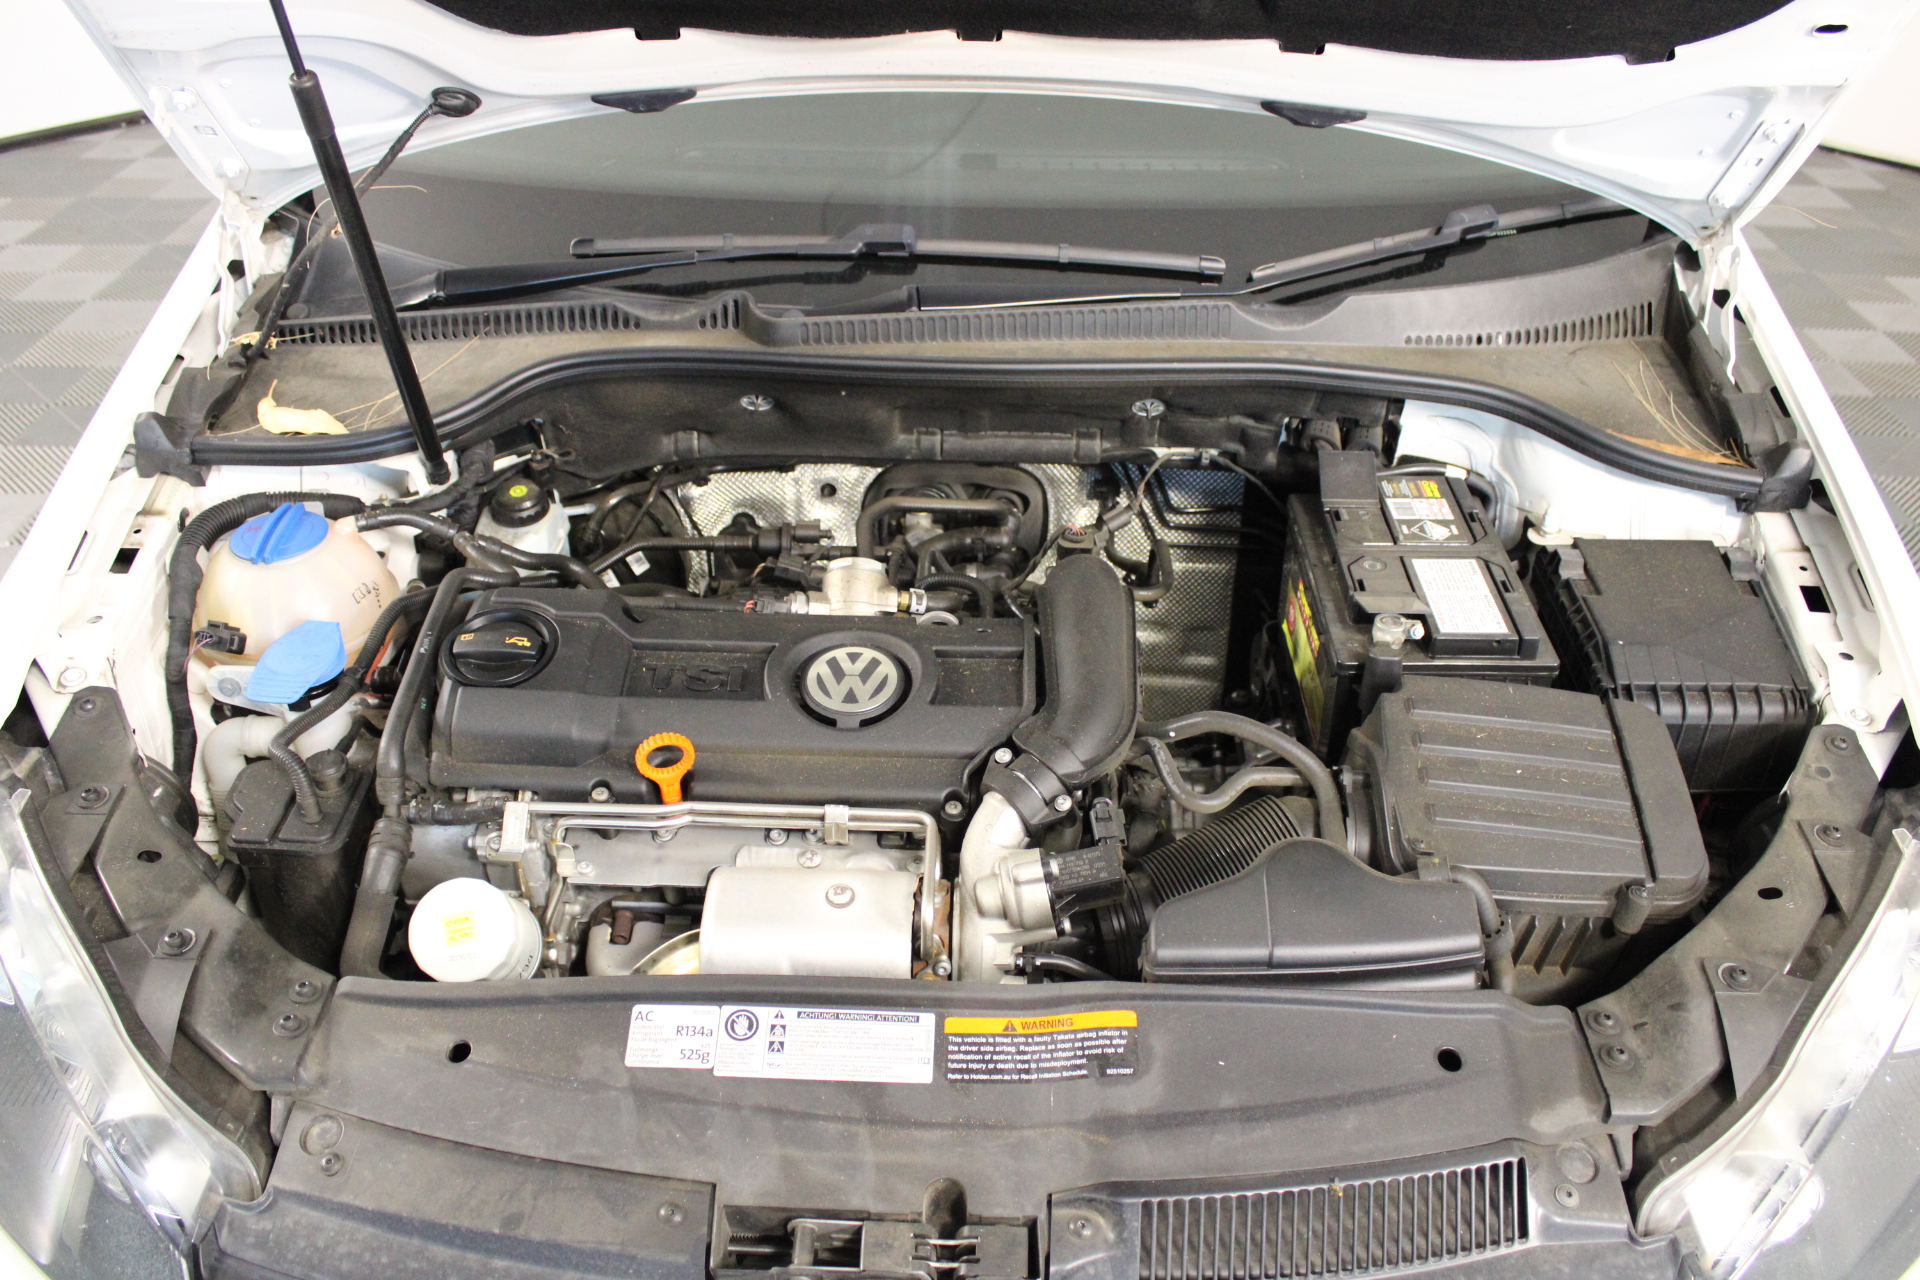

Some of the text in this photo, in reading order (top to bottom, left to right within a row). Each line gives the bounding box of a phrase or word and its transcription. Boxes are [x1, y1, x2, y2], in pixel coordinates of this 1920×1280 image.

[644, 664, 746, 693] TSI
[634, 1010, 655, 1022] AC
[799, 1012, 917, 1022] ACHTUNG! WARNING! ATTENTION!
[1021, 1018, 1074, 1031] WARNING
[676, 1025, 713, 1038] R134a
[1033, 1035, 1052, 1043] faulty
[1076, 1031, 1097, 1039] airbag
[995, 1045, 1018, 1053] airbag.
[1020, 1044, 1046, 1053] Replace
[1083, 1039, 1111, 1047] possible
[679, 1049, 710, 1064] 525g
[1053, 1050, 1075, 1058] inflator
[1084, 1048, 1102, 1056] avoid
[968, 1062, 987, 1070] injury
[1038, 1058, 1089, 1069] misdeployment.
